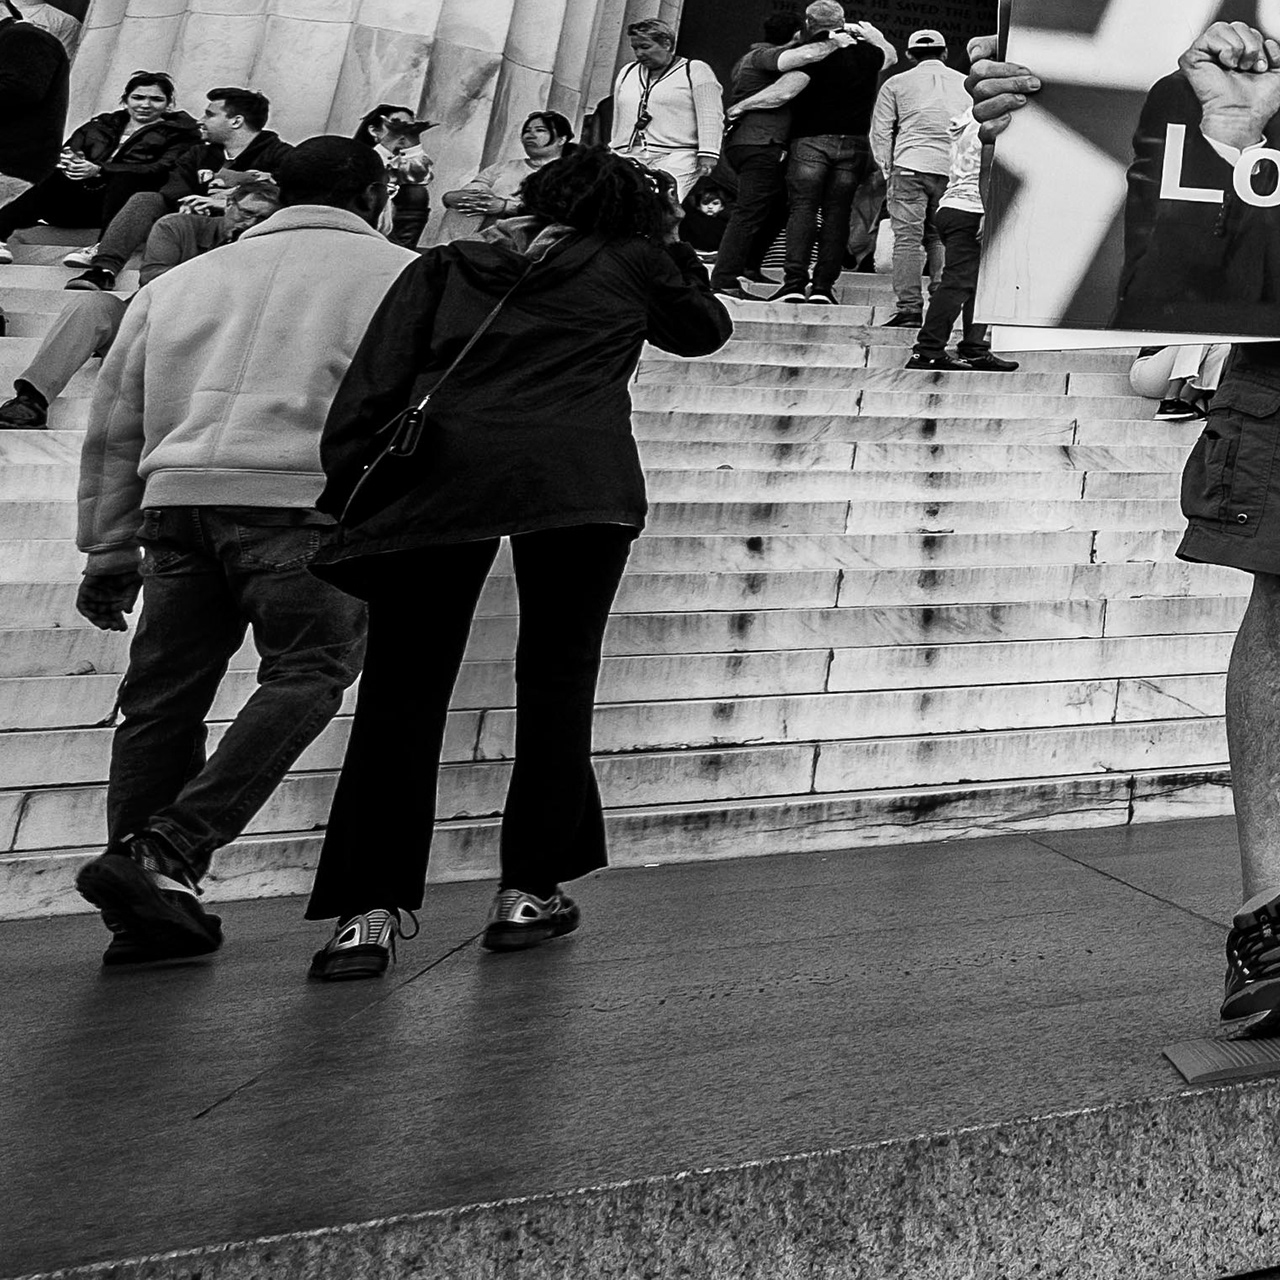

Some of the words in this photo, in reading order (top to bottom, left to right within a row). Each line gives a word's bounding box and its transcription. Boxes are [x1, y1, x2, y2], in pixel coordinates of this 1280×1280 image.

[896, 1, 939, 15] SAVED
[945, 7, 971, 20] THE
[894, 16, 961, 32] ABRAHAM
